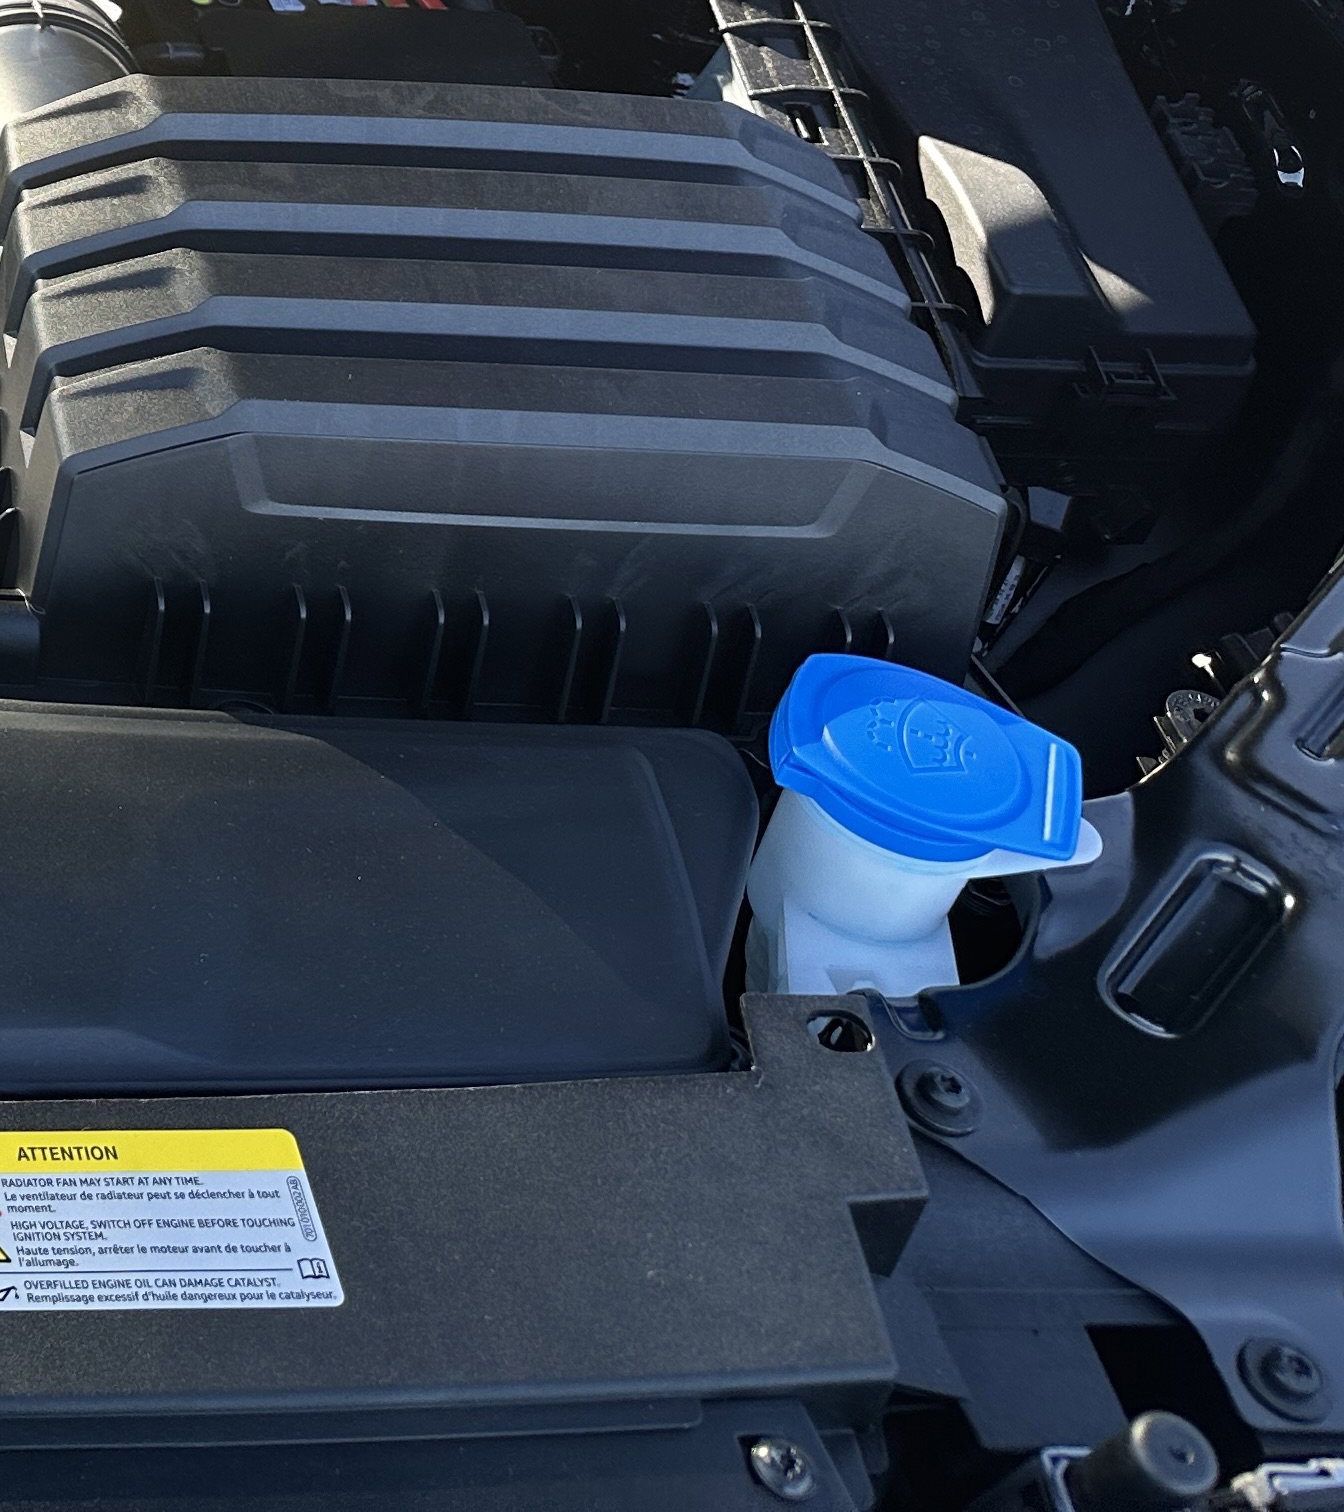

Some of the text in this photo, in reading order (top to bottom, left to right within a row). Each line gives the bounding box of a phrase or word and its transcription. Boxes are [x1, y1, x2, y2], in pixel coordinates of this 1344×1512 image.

[18, 1146, 118, 1161] ATTENTION
[2, 1178, 54, 1188] RADIATOR
[56, 1178, 76, 1187] FAN
[80, 1178, 101, 1187] MAY
[103, 1178, 135, 1187] START
[138, 1177, 150, 1186] AT
[152, 1177, 172, 1186] ANY
[4, 1192, 16, 1201] Le
[20, 1192, 77, 1201] ventilateur
[80, 1191, 93, 1200] de
[96, 1191, 144, 1200] radiateur
[148, 1191, 170, 1202] peut
[189, 1190, 245, 1199] déclencher
[257, 1190, 280, 1198] tout
[7, 1204, 56, 1213] moment.
[11, 1221, 36, 1230] HIGH
[91, 1220, 131, 1229] SWITCH
[134, 1220, 153, 1229] OFF
[156, 1219, 195, 1228] ENGINE
[199, 1219, 239, 1228] BEFORE
[242, 1218, 295, 1228] TOUCHING
[14, 1232, 107, 1241] IGNITION SYSTEM.
[16, 1246, 49, 1255] Haute
[51, 1246, 95, 1256] tension,
[98, 1245, 135, 1254] arrêter
[138, 1245, 147, 1254] le
[150, 1245, 189, 1254] moteur
[192, 1244, 221, 1254] avant
[225, 1244, 238, 1253] de
[241, 1244, 281, 1253] toucher
[19, 1258, 79, 1269] l'allumage.
[24, 1278, 225, 1289] OVERFILLED ENGINE OIL CAN DAMAGE
[27, 1291, 276, 1304] Remplissage excessif d'huile dangereux pour le
